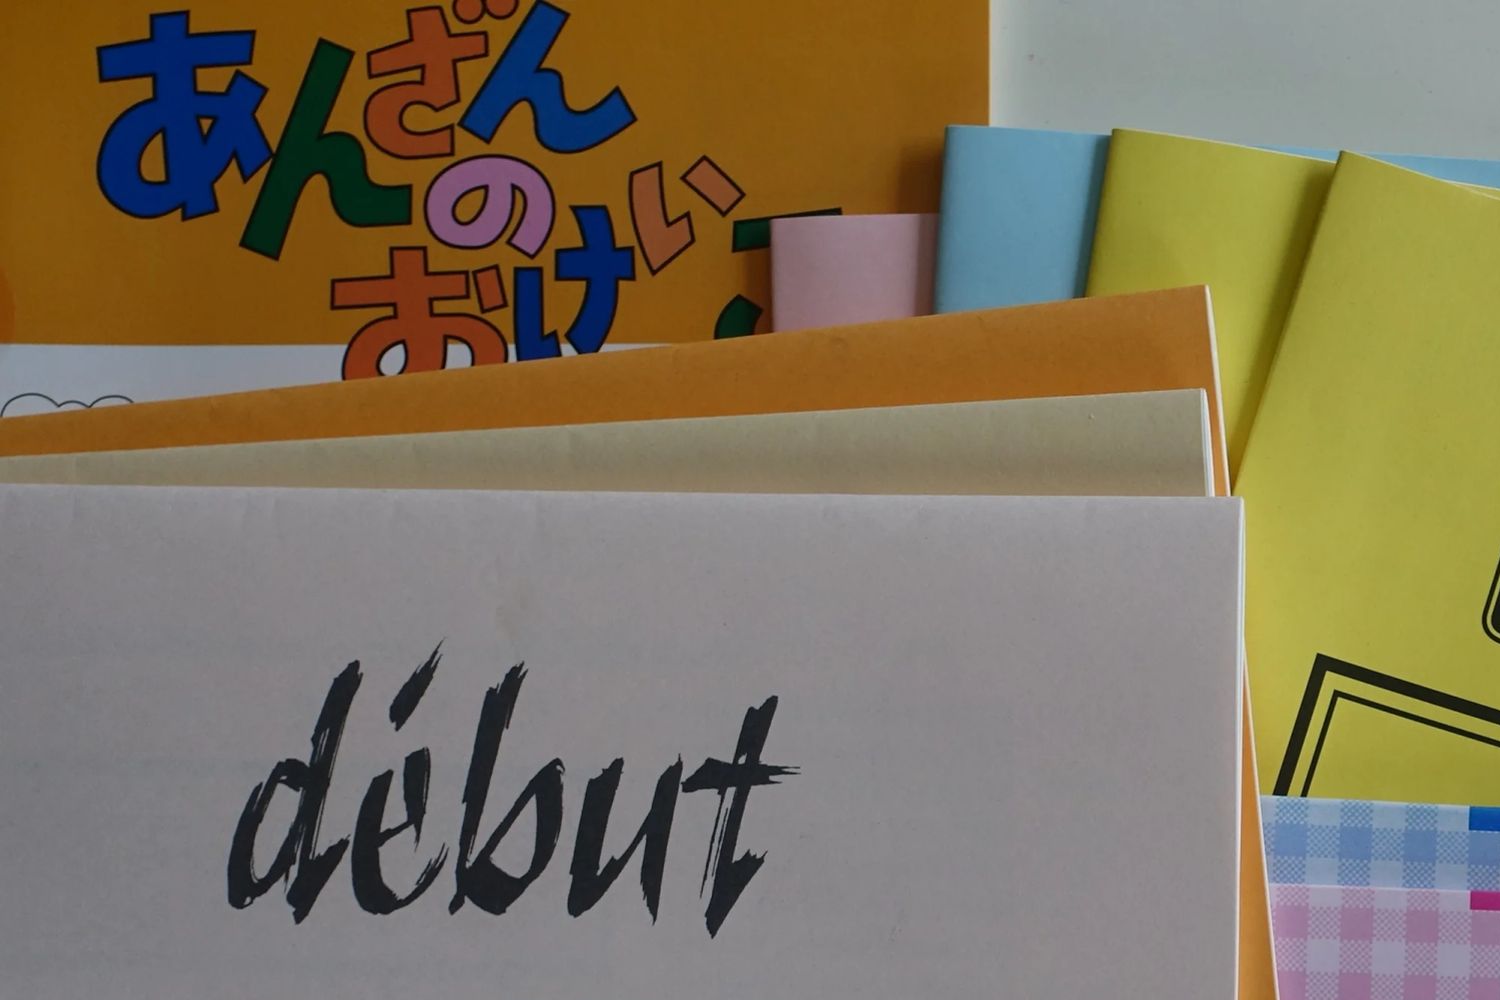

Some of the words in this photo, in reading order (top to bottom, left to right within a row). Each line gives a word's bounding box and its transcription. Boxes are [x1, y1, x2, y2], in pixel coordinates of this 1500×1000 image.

[97, 0, 637, 260] あんざん
[424, 155, 556, 258] の
[227, 637, 801, 939] début
